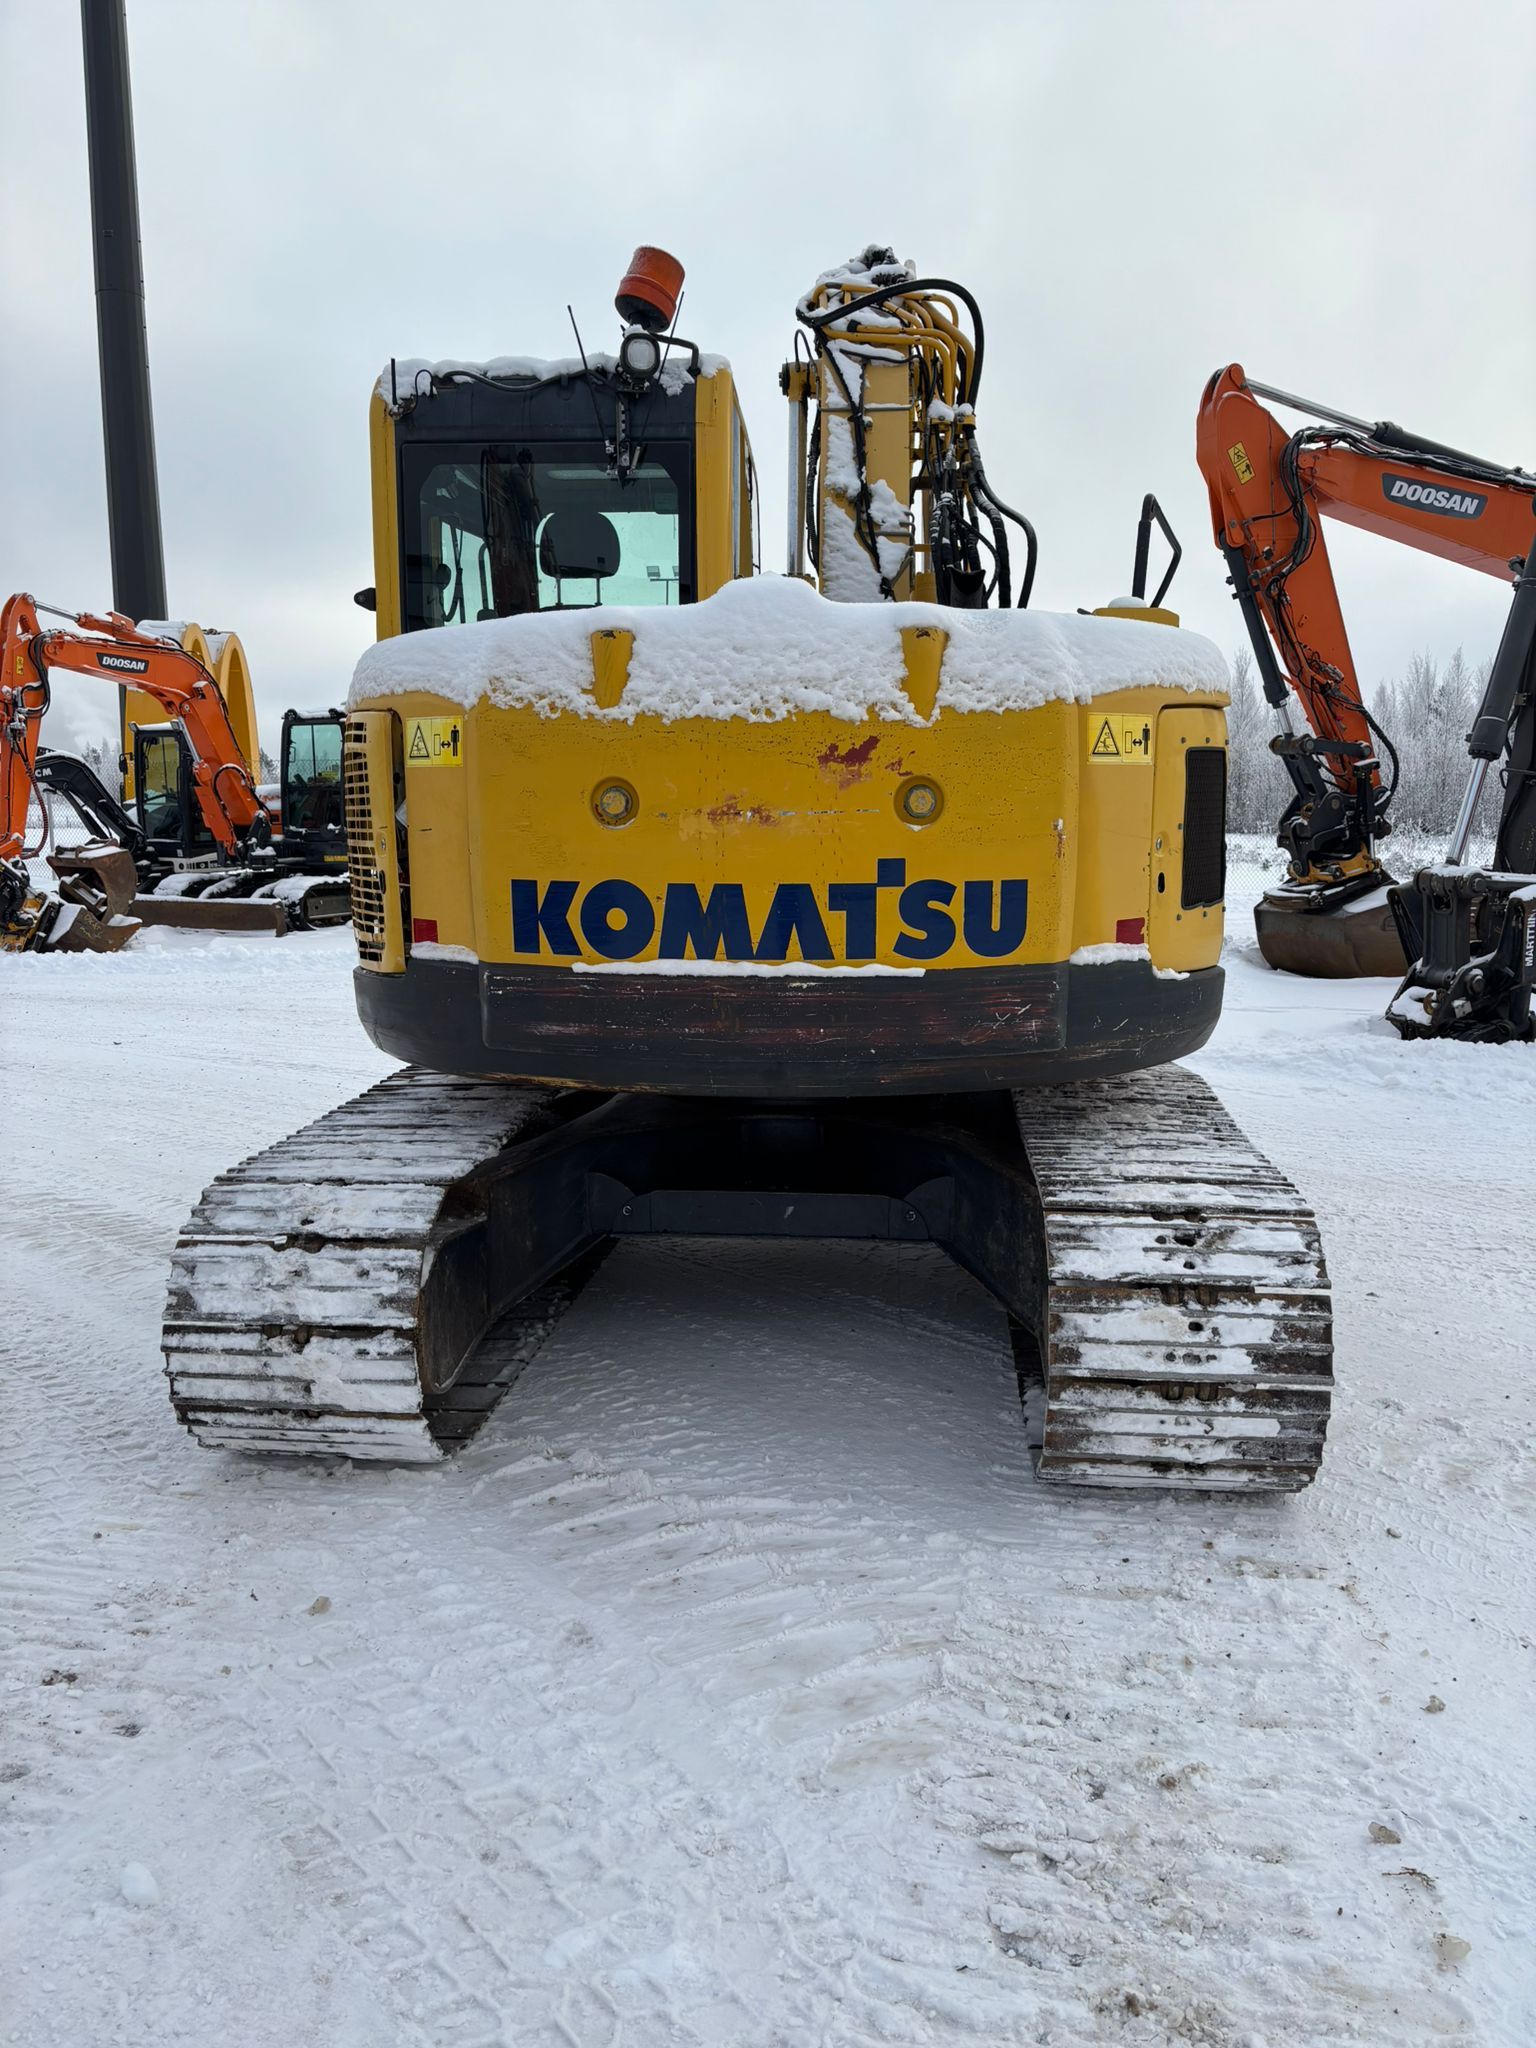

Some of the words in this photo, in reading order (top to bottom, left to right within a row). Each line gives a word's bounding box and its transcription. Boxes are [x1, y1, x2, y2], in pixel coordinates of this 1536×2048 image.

[1390, 480, 1479, 515] DOOSAN
[102, 656, 146, 671] DOOSAN
[511, 858, 1028, 960] KOMATSU
